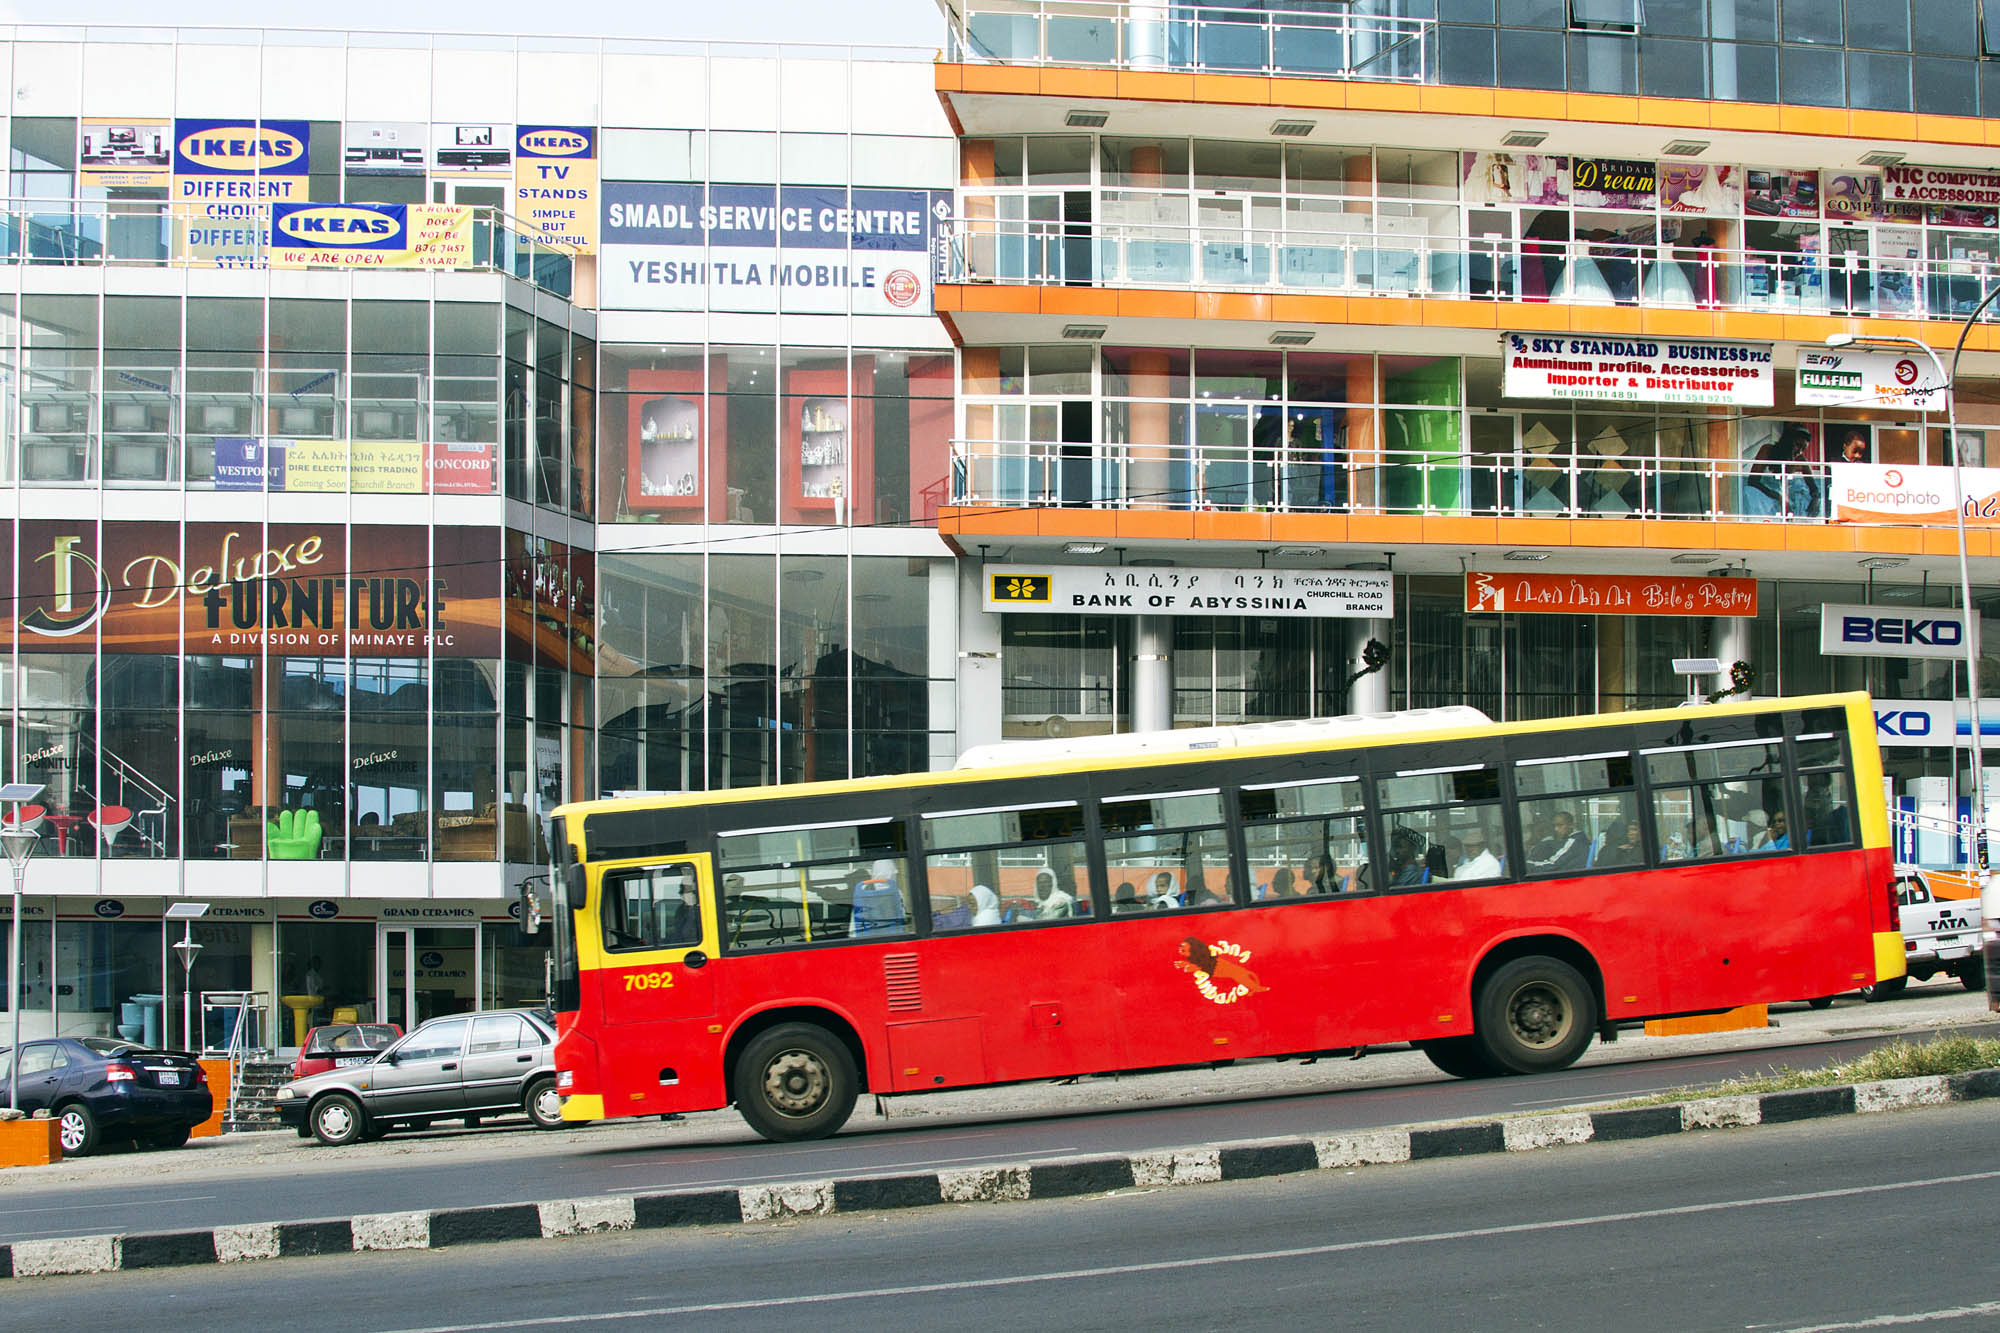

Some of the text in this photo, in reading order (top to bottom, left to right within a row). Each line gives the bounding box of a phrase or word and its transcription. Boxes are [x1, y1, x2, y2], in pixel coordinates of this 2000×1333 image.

[190, 139, 292, 157] IKEAS
[525, 136, 582, 148] IKEAS
[537, 165, 570, 180] TV
[1573, 161, 1655, 191] Dream
[1602, 163, 1656, 174] BRIDALS
[1886, 168, 2000, 187] NIC COMPUTE
[183, 181, 292, 198] DIFFERENT
[518, 188, 588, 200] STANDS
[1895, 186, 2000, 204] & ACCESSORIE
[532, 209, 576, 219] SIMPLE
[608, 203, 921, 235] SMADL SERVICE CENTRE
[289, 217, 390, 234] IKEAS
[542, 222, 566, 231] BUT
[519, 235, 588, 245] BAUTIFUL
[284, 252, 385, 265] WE ARE OPEN
[419, 257, 458, 265] SMART
[629, 260, 876, 288] YESHITLA MOBILE
[1532, 338, 1771, 363] SKY STANDARD BUSINESS PLC
[1512, 356, 1592, 372] Aluminum
[1661, 363, 1759, 378] Accessories
[1547, 373, 1619, 388] Importer
[1628, 378, 1638, 388] &
[1802, 374, 1861, 388] FUJIFILM
[1552, 388, 1567, 397] Tel
[1571, 390, 1593, 398] 0911
[288, 464, 310, 472] DIRE
[378, 466, 418, 474] TRADING
[1847, 488, 1940, 507] Benonphoto
[124, 531, 324, 608] Deluxe
[1104, 572, 1283, 589] አቢሲንያ ባንክ
[202, 577, 448, 630] FURNITURE
[1072, 593, 1307, 610] BANK OF ABYSSINIA
[1306, 591, 1354, 599] CHURCHILL
[1698, 582, 1752, 610] Pastry
[1842, 616, 1963, 646] BEKO
[212, 633, 454, 647] A DIVISION OF MINAYE PLC
[1873, 711, 1931, 736] KO
[22, 743, 65, 766] Deluxe
[190, 748, 233, 767] Deluxe
[352, 750, 398, 769] Deluxe
[212, 908, 265, 917] CERAMICS
[383, 908, 474, 917] GRAND CERAMICS
[1927, 917, 1969, 931] TATA
[392, 969, 424, 978] GRND
[623, 971, 675, 992] 7092
